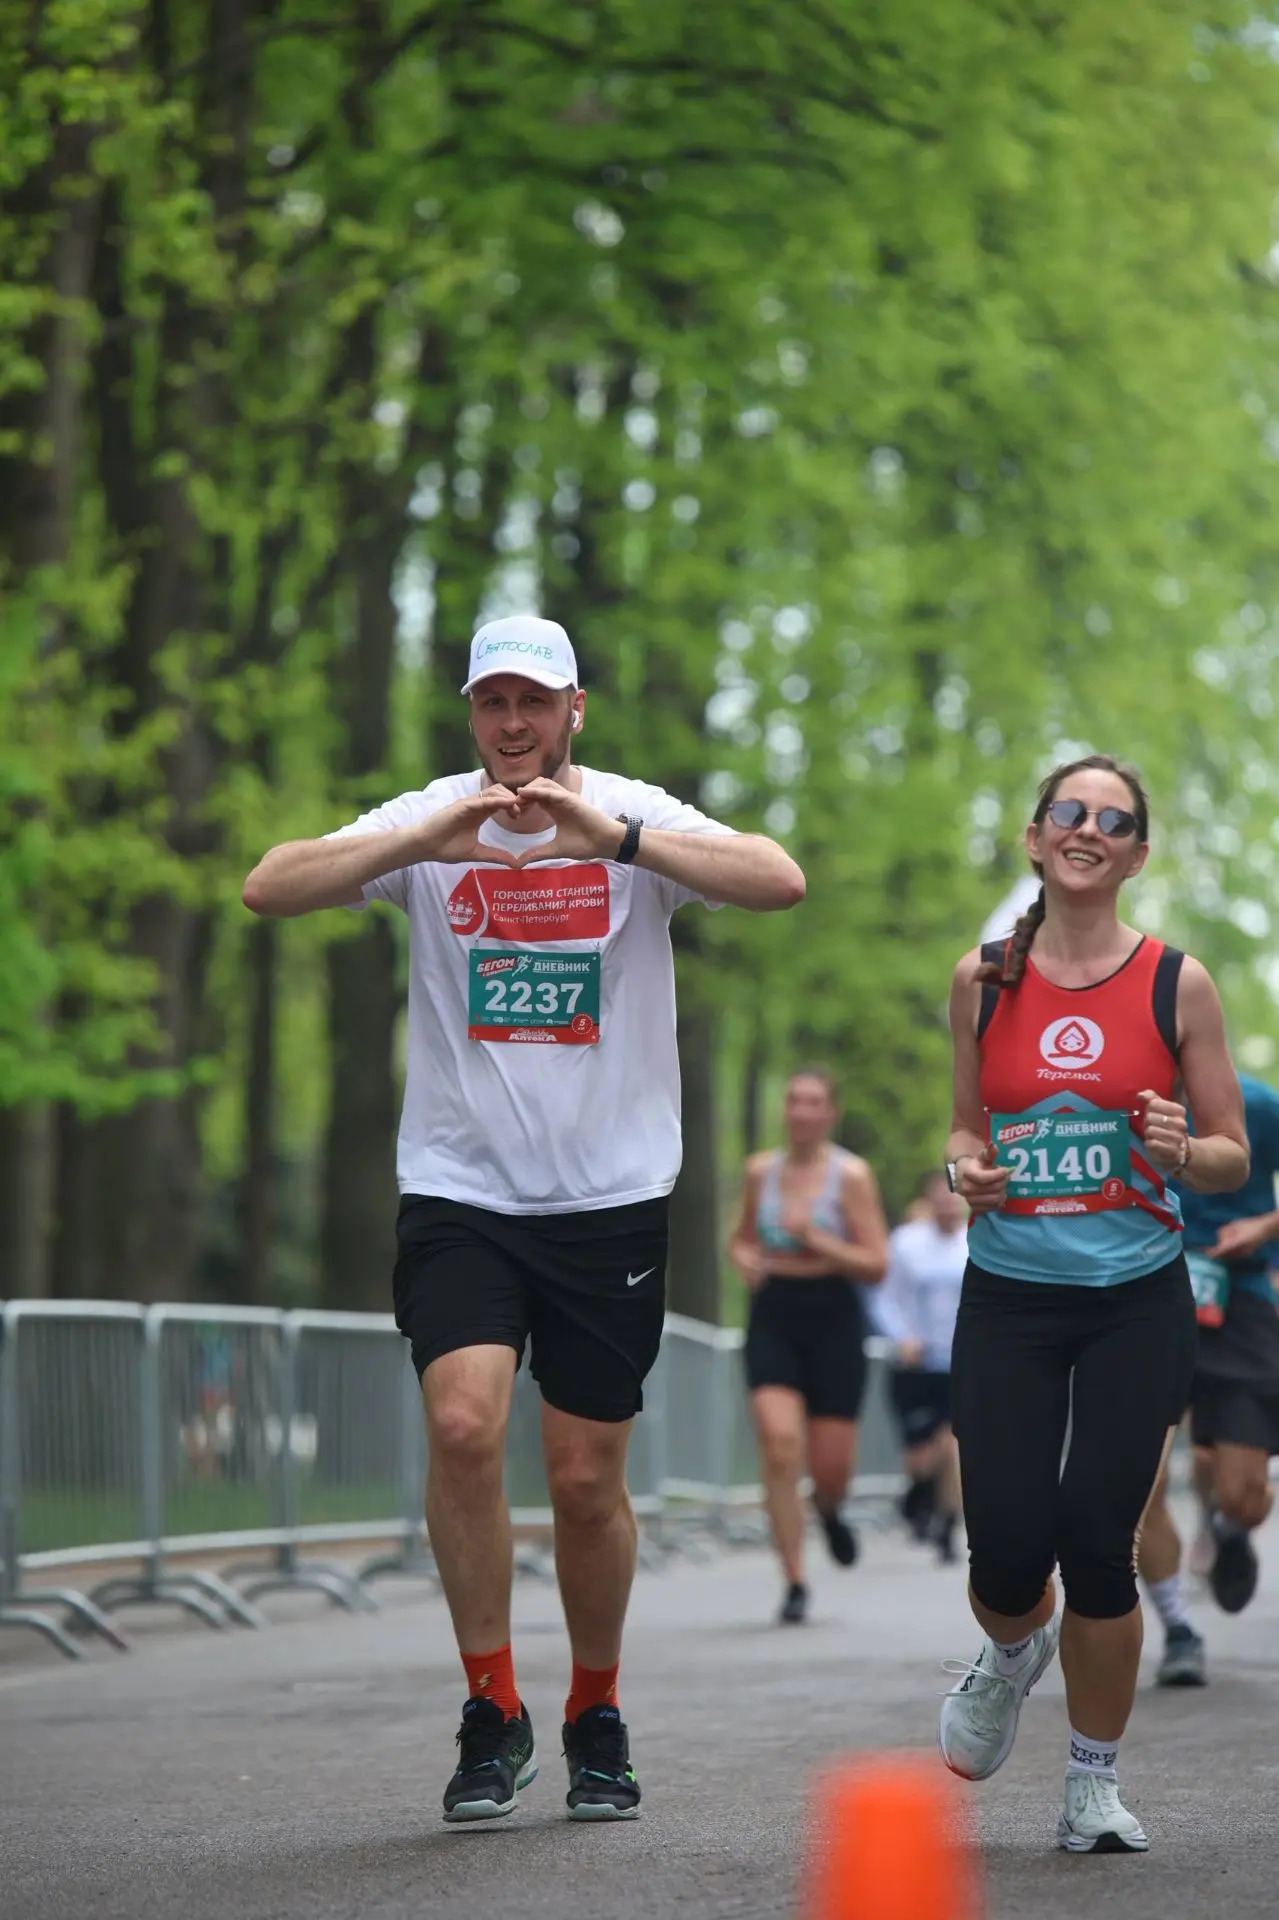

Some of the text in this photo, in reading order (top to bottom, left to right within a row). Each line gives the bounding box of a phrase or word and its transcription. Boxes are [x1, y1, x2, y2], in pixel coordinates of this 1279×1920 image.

[493, 885, 604, 901] ГОРОДСКАЯ СТАНЦИЯ
[492, 898, 605, 912] ПЕРЕЛИВАНИЯ КРОВИ
[493, 912, 570, 924] Санкт-Петербург
[476, 957, 516, 973] БЕГОМ
[533, 961, 590, 972] ДНЕВНИК
[484, 979, 584, 1014] 2237
[1036, 1068, 1102, 1082] Теремок
[997, 1122, 1036, 1141] БЕГОМ
[1055, 1121, 1118, 1135] ДНЕВНИК
[1007, 1144, 1111, 1183] 2140
